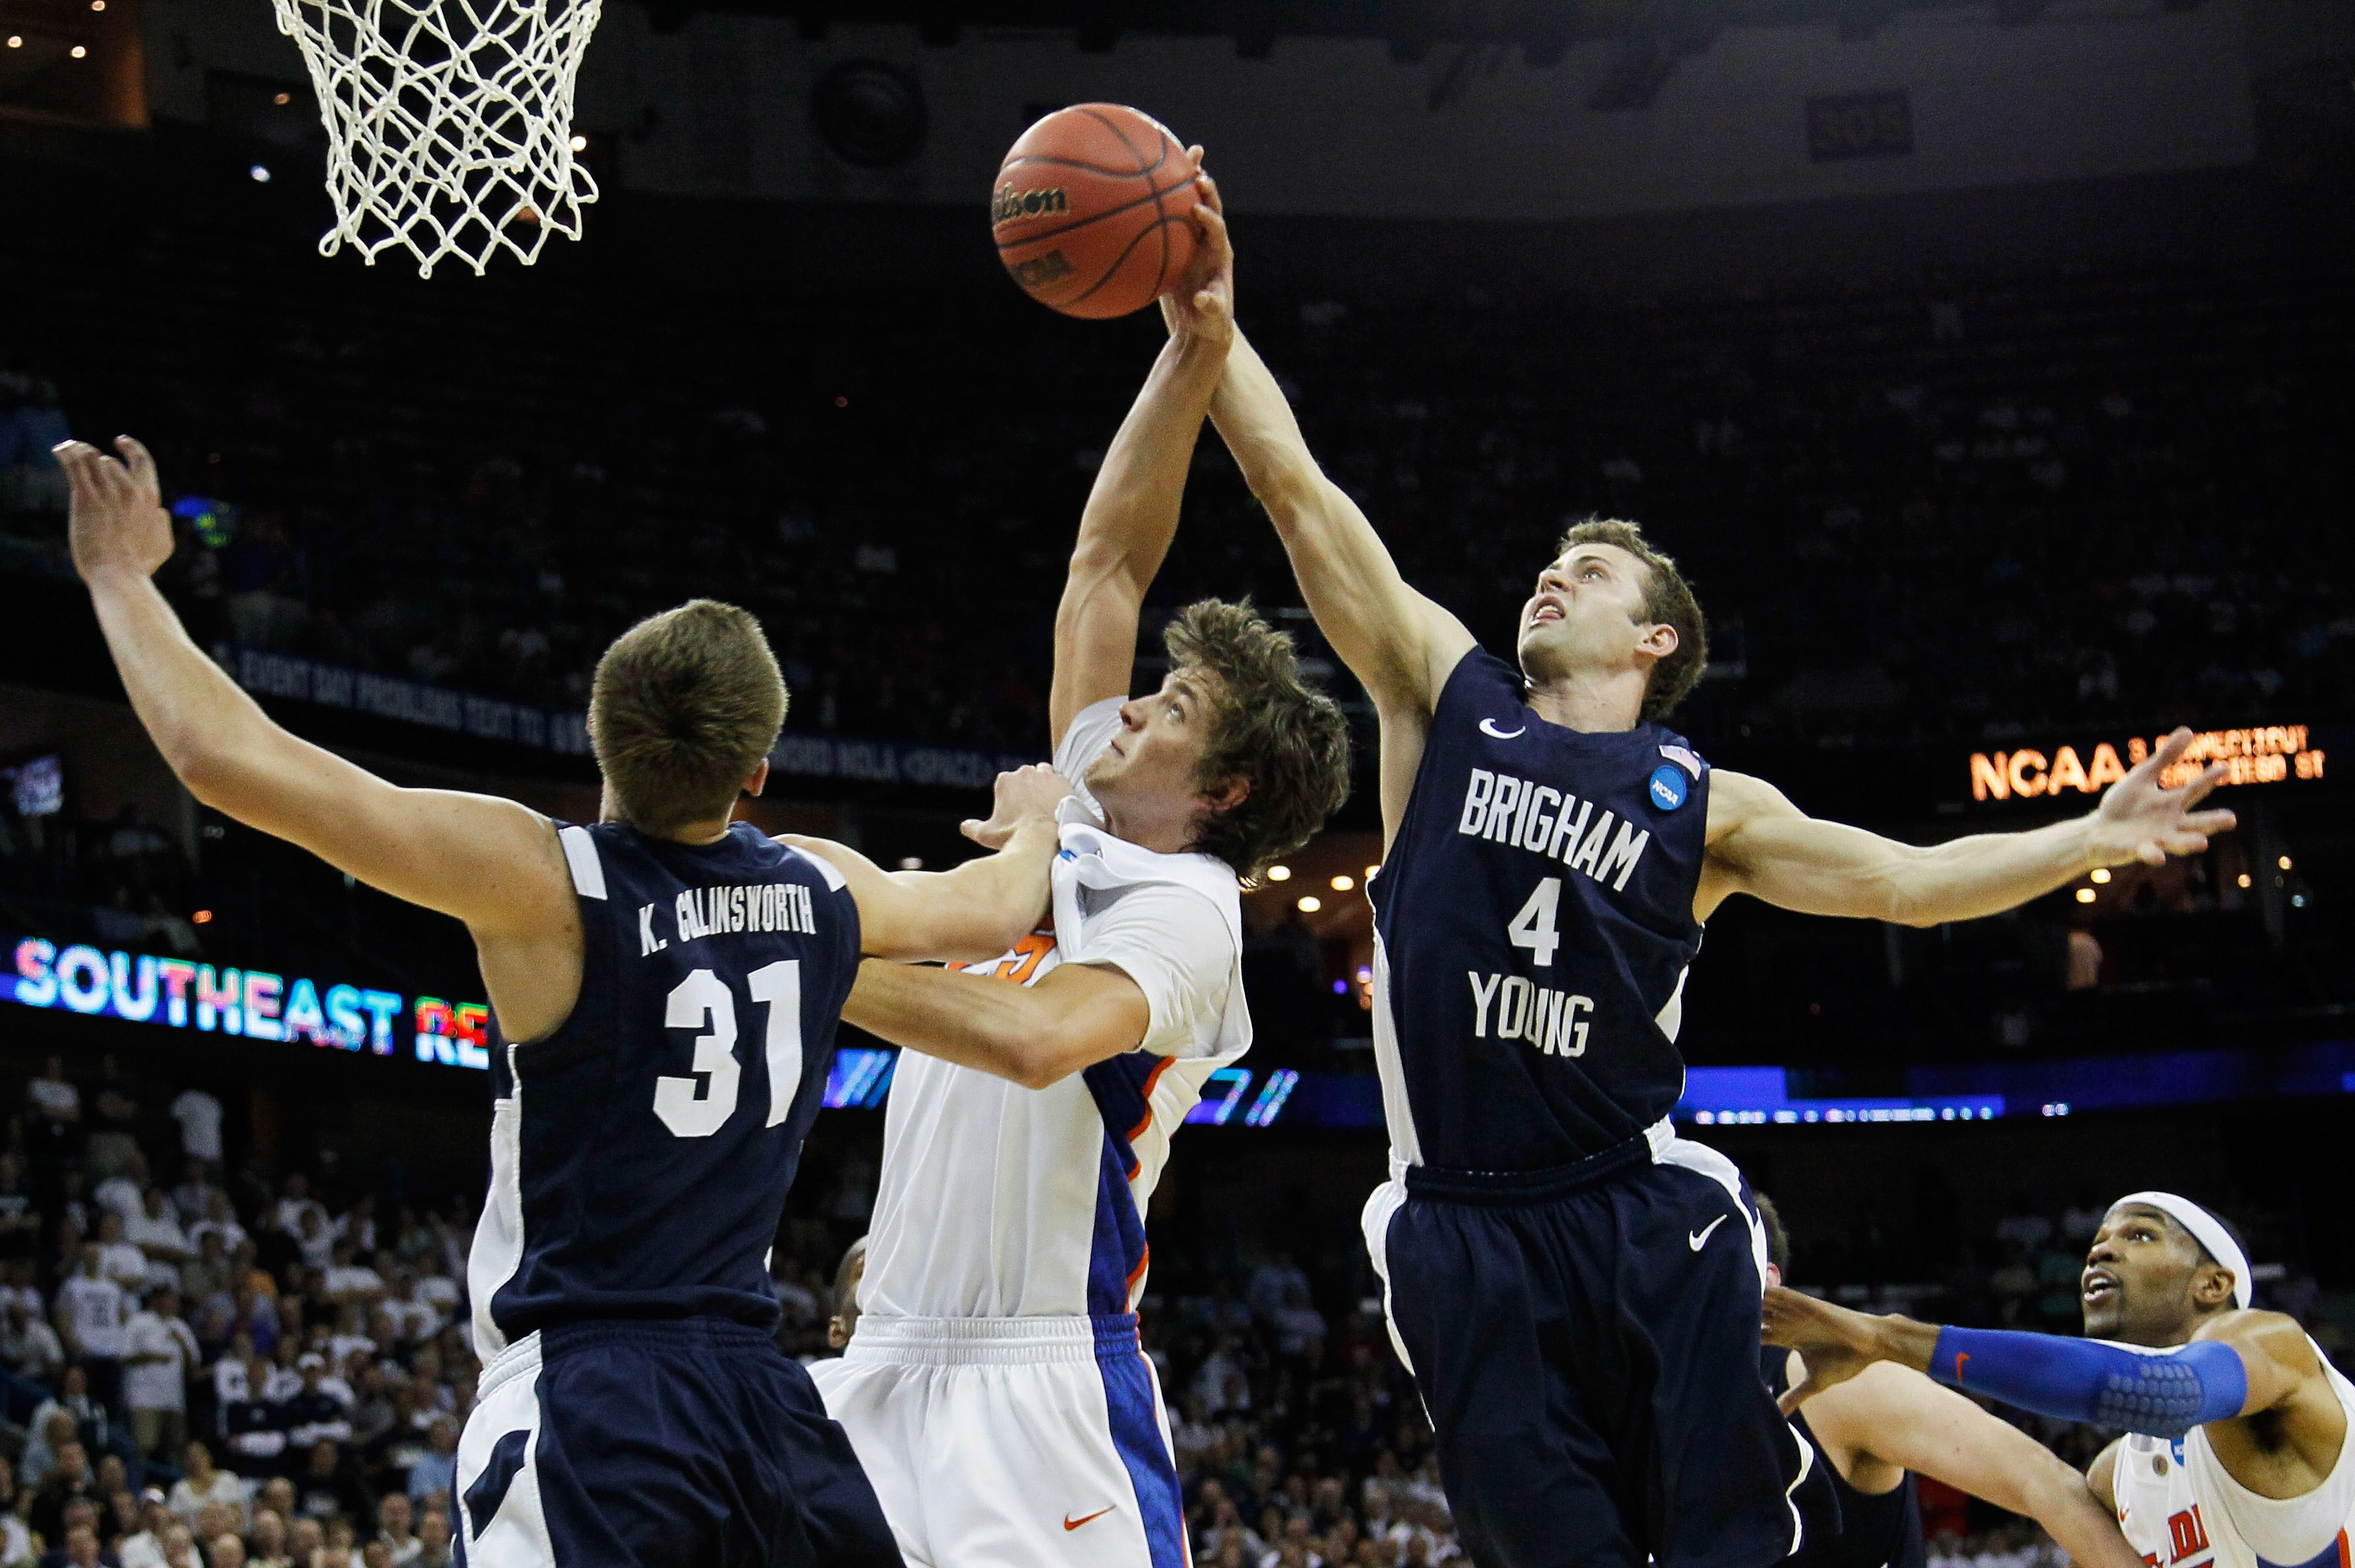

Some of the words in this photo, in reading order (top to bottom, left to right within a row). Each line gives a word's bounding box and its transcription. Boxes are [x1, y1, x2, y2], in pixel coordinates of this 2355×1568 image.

[1652, 779, 1679, 805] NCAA
[1970, 742, 2127, 800] NCAA
[1458, 768, 1650, 892] BRIGHAM
[638, 903, 668, 957] K.
[1508, 877, 1562, 967] 4
[14, 937, 402, 1055] SOUTHEAST
[1468, 971, 1594, 1057] YOUNG
[653, 960, 803, 1138] 31
